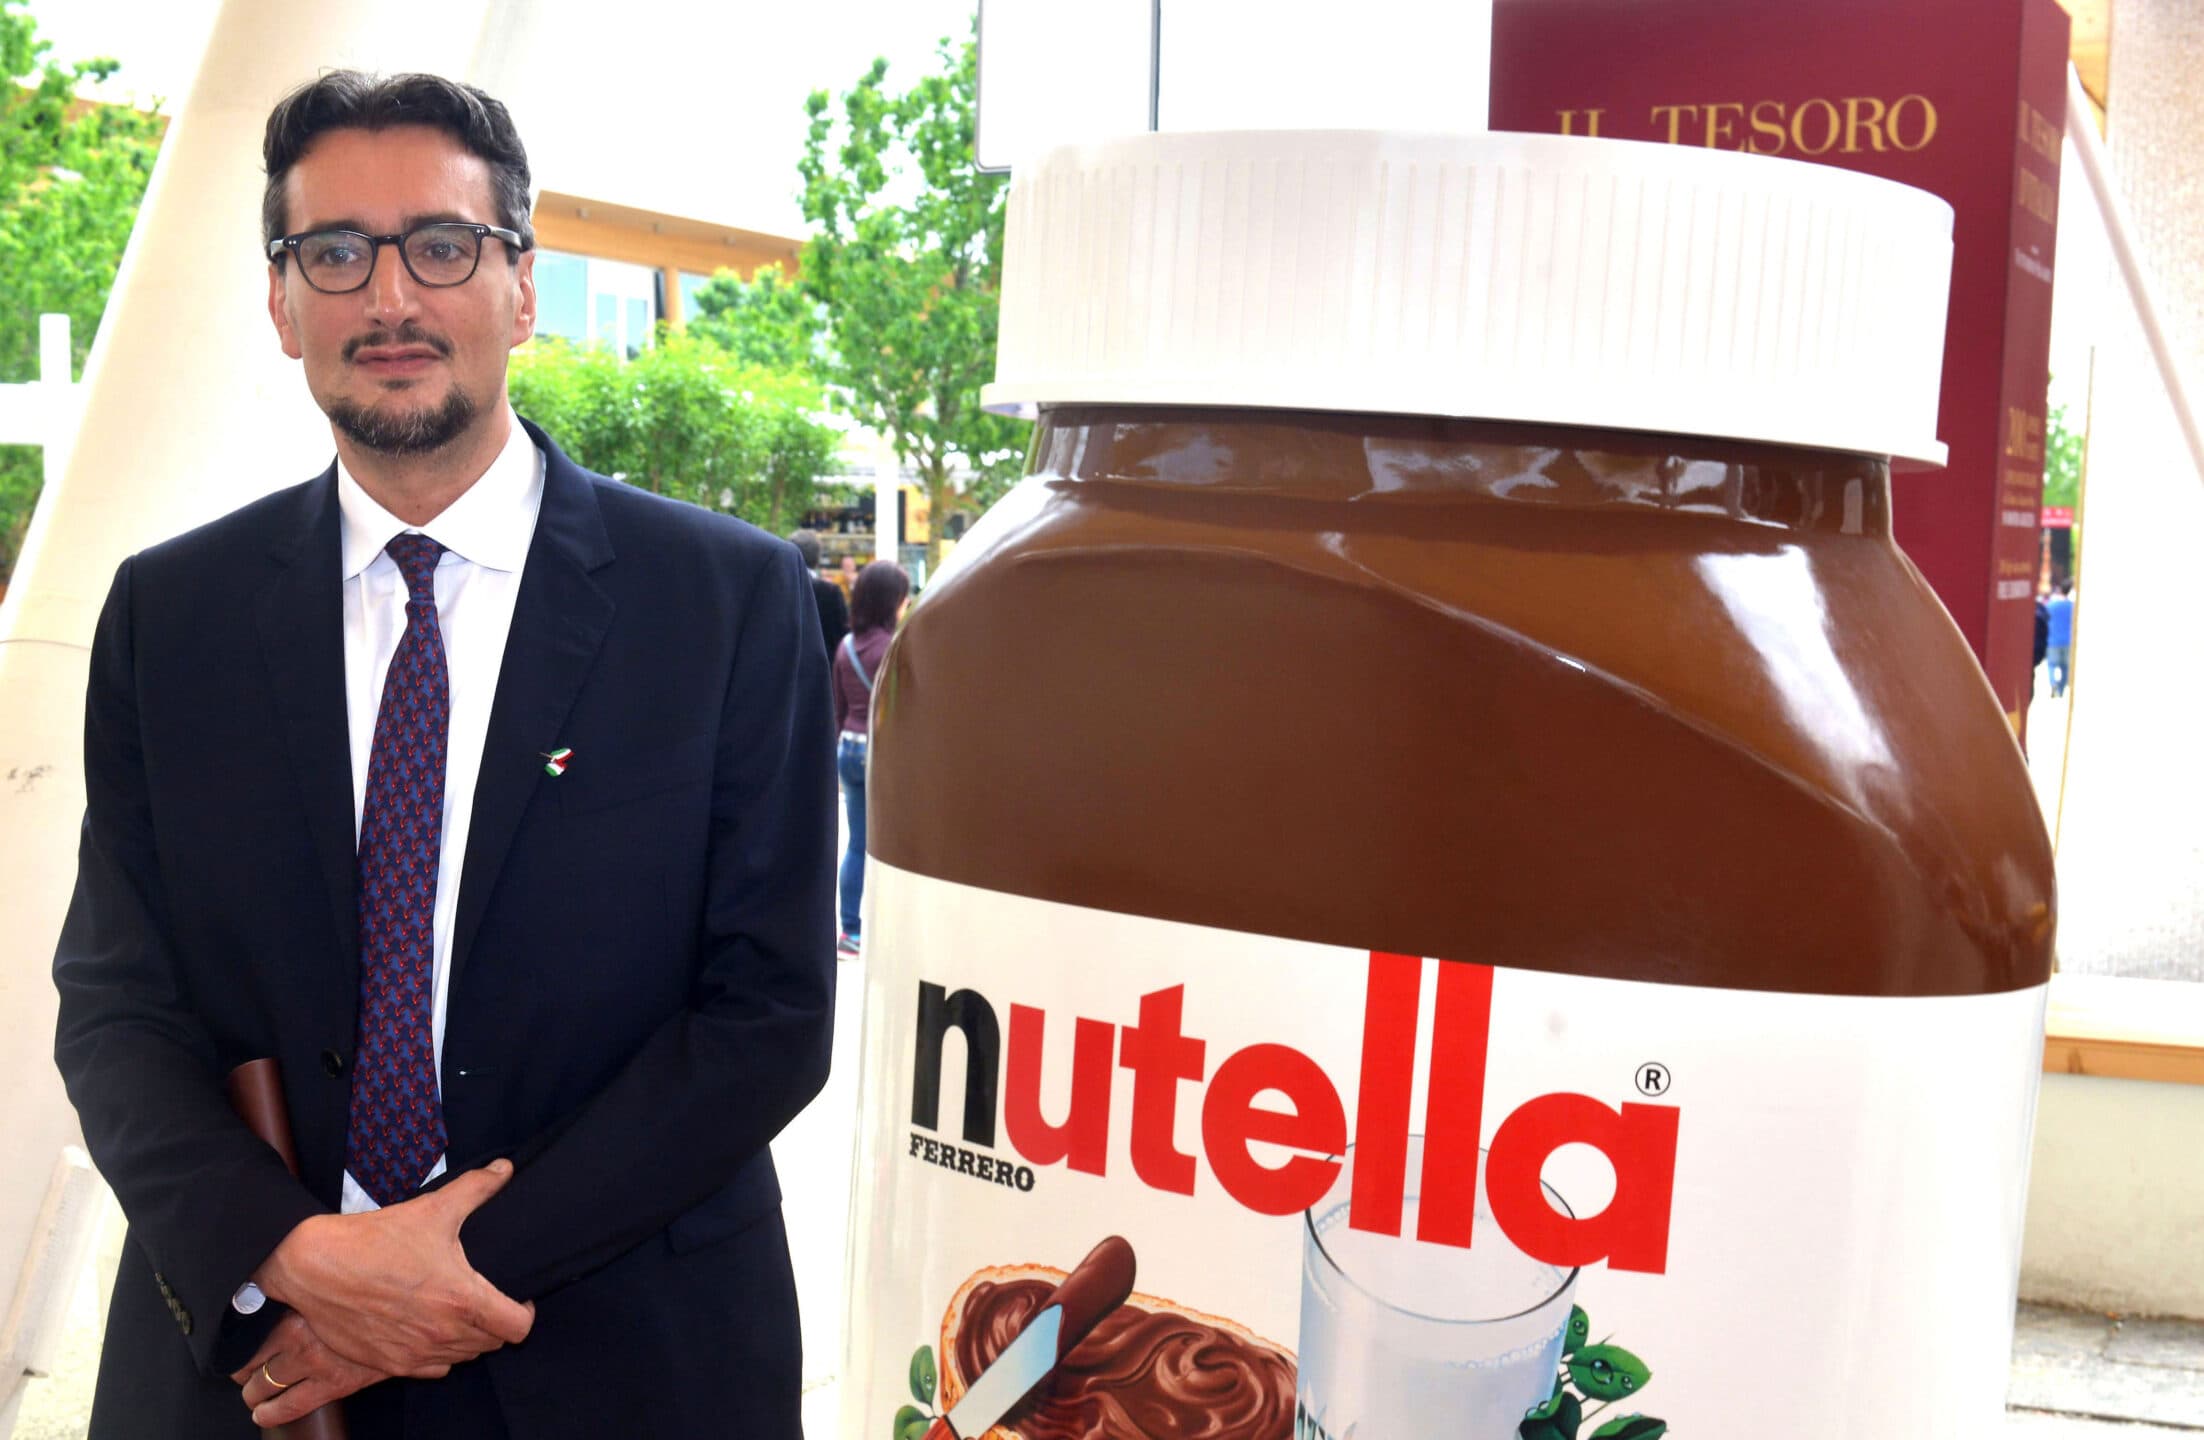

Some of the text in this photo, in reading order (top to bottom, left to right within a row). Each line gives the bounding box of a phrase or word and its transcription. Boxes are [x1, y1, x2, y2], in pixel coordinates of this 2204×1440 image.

[1651, 94, 1938, 155] TESORO
[911, 950, 1680, 1275] nutella
[909, 1132, 1035, 1192] FERRERO
